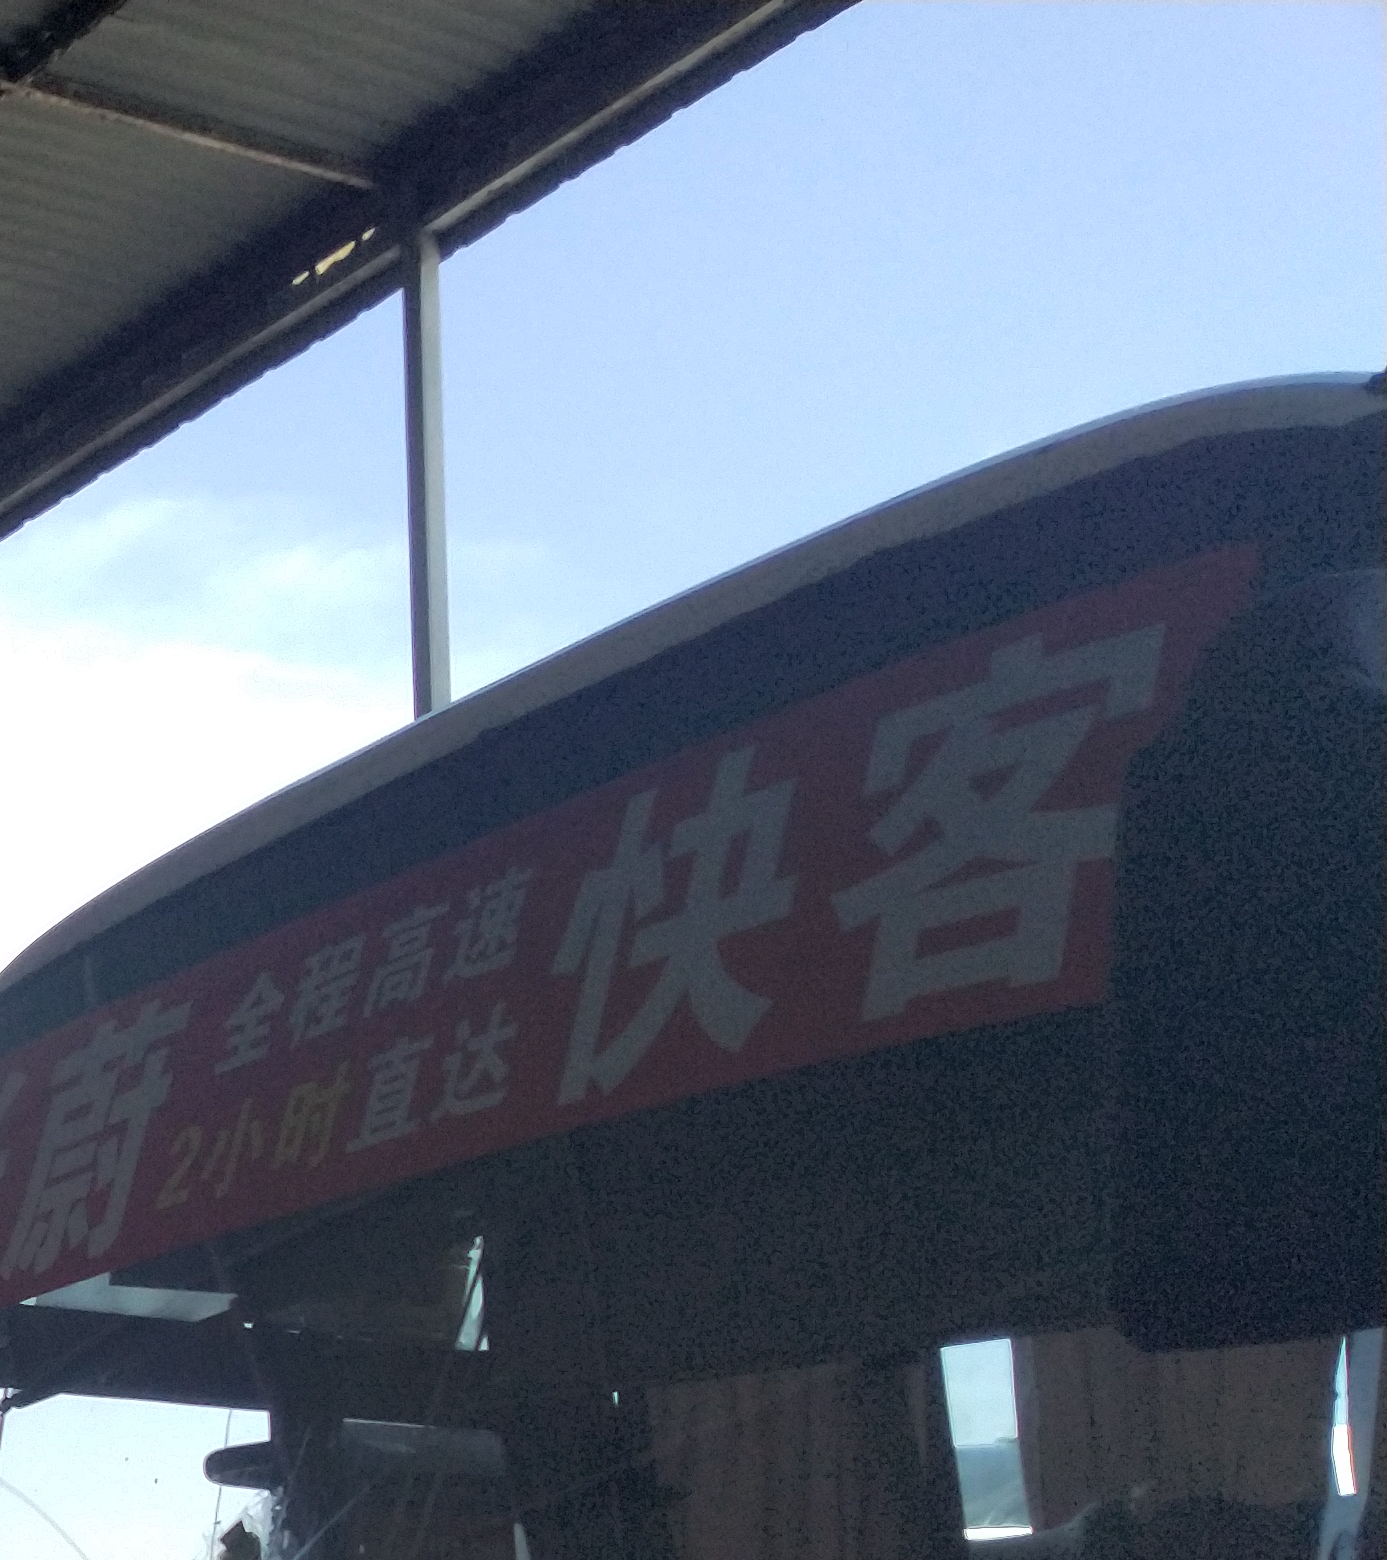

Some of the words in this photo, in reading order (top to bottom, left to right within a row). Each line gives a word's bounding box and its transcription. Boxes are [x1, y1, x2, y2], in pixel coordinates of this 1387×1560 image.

[214, 866, 533, 1076] 全程高速
[549, 622, 1168, 1107] 快客
